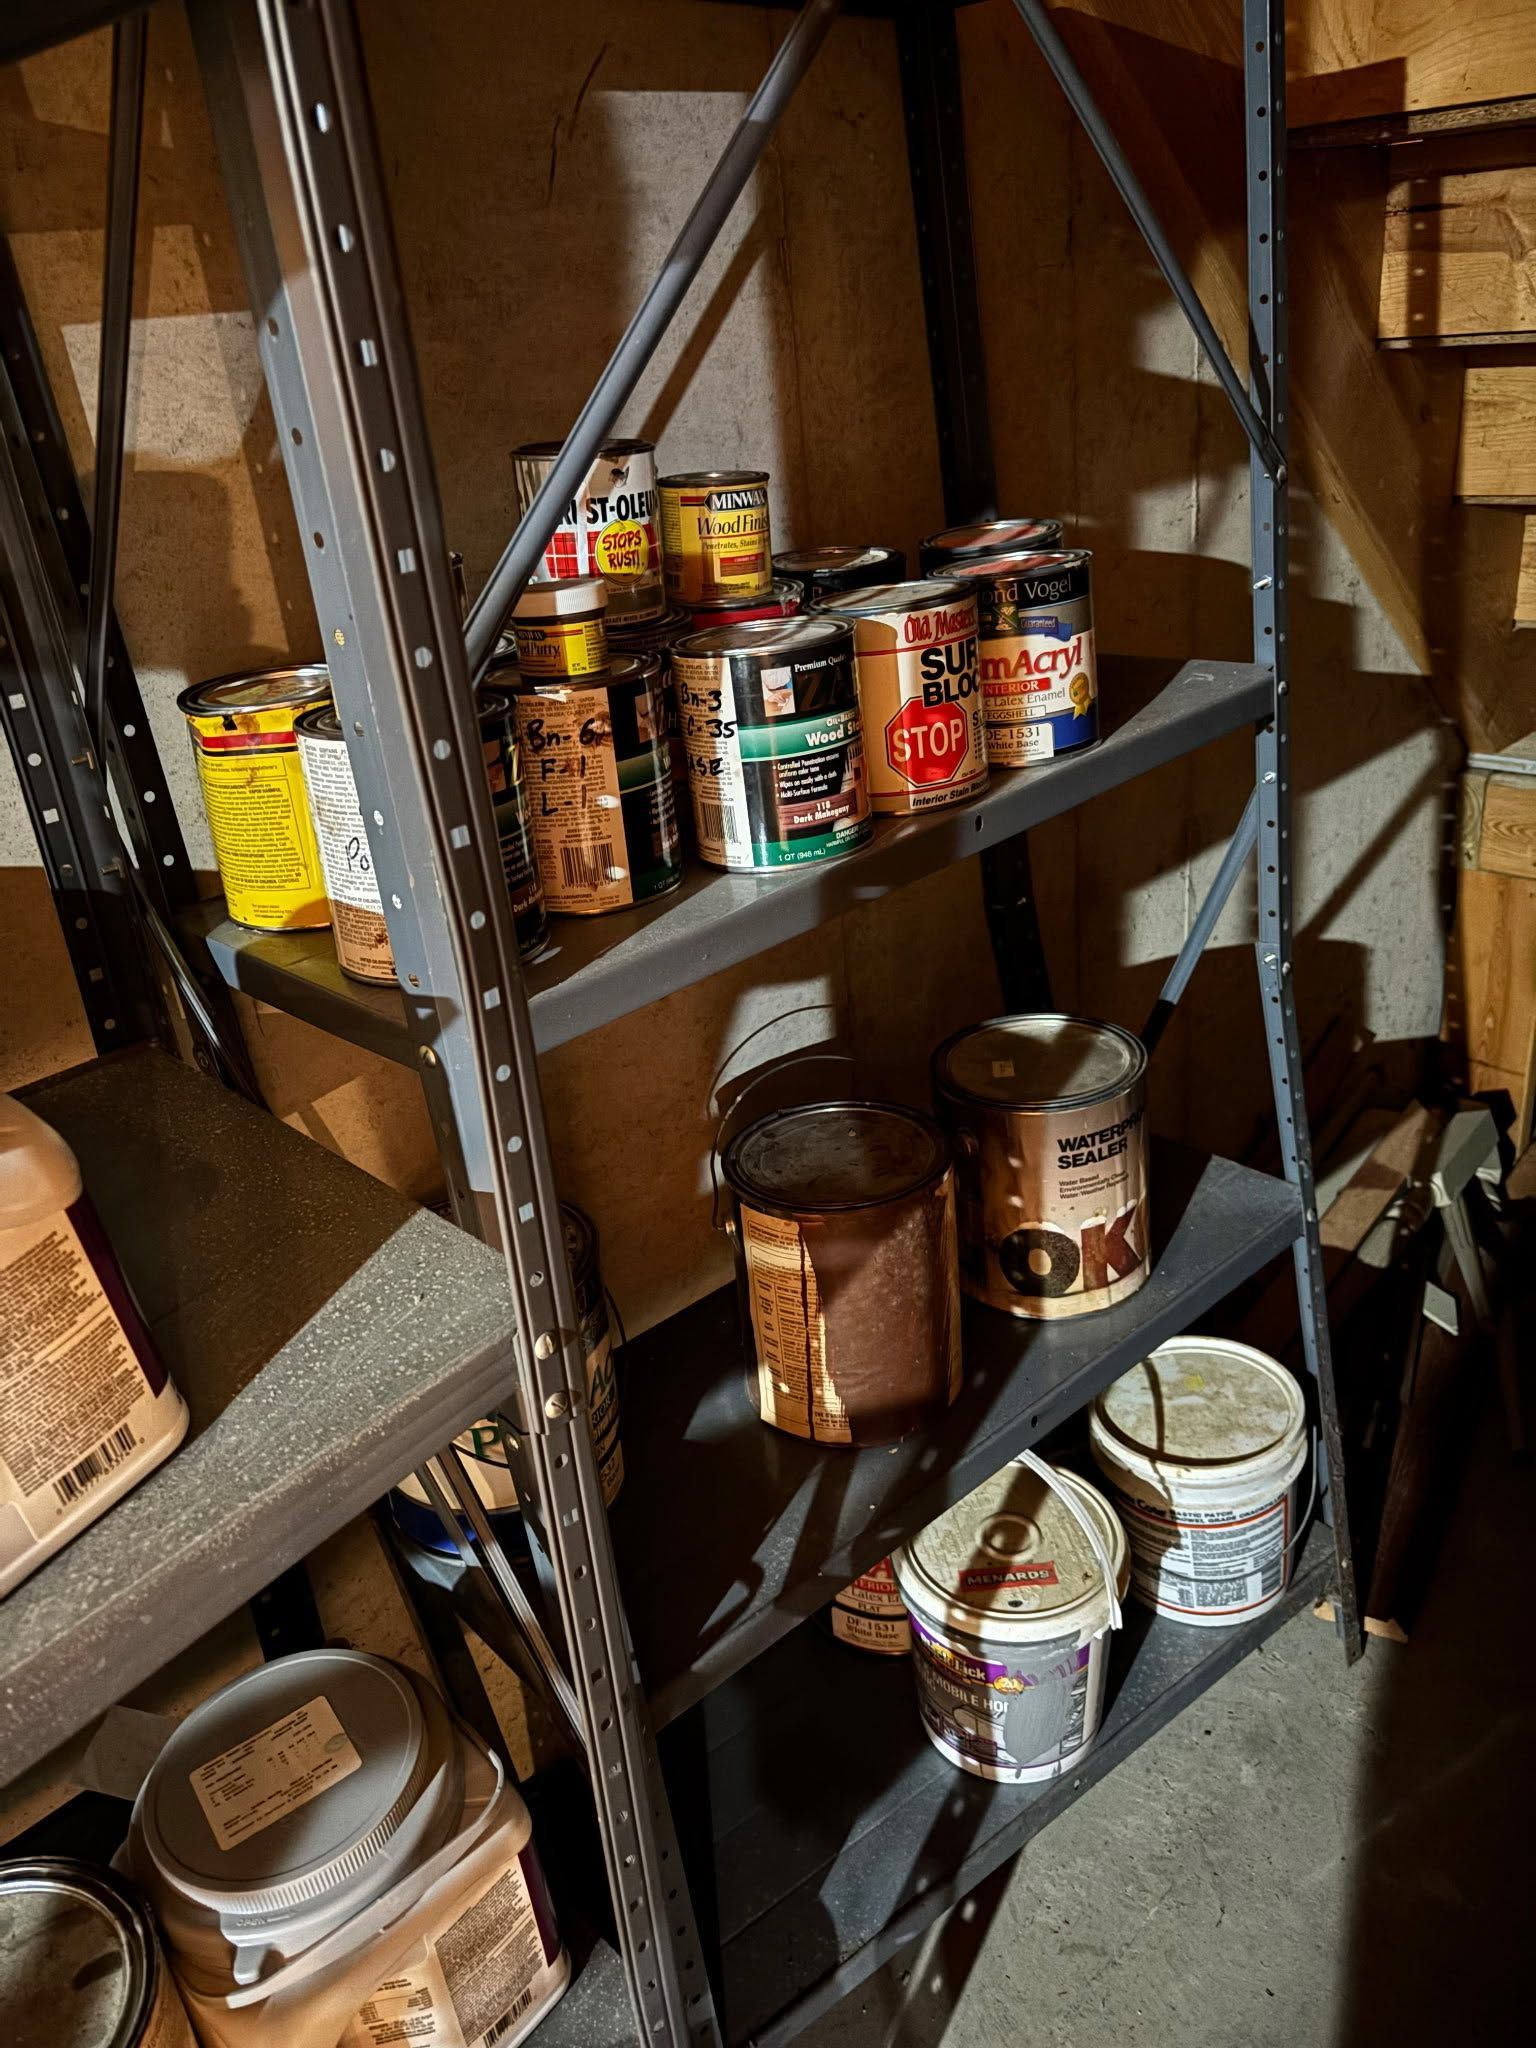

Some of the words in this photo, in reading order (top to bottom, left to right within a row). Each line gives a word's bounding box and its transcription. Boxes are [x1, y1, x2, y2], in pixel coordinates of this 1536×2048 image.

[711, 488, 766, 510] MINWAX
[697, 514, 741, 536] Wood
[743, 513, 769, 533] Finis
[602, 529, 642, 552] STOPS
[607, 547, 642, 571] RUST!
[1024, 572, 1072, 601] Vogel
[794, 659, 827, 673] Premium
[981, 636, 1084, 679] mAcryl
[923, 668, 980, 708] BLOC
[985, 680, 1040, 695] NTERIOR
[994, 696, 1025, 707] Latex
[1027, 688, 1066, 704] Enamel
[987, 708, 1034, 720] EGGSHELL
[805, 724, 845, 747] Wood
[893, 718, 964, 763] STOP
[1016, 739, 1039, 749] Base
[911, 793, 948, 807] Interior
[793, 813, 814, 824] Dark
[815, 805, 850, 821] Mahogany
[784, 852, 796, 862] QT
[1057, 1136, 1128, 1170] SEALER
[1059, 1179, 1078, 1187] Water
[1079, 1173, 1100, 1183] Based
[1204, 1510, 1233, 1518] PATCH
[966, 1569, 1050, 1585] MENARDS
[858, 1602, 881, 1613] FLAT
[875, 1630, 899, 1639] Base
